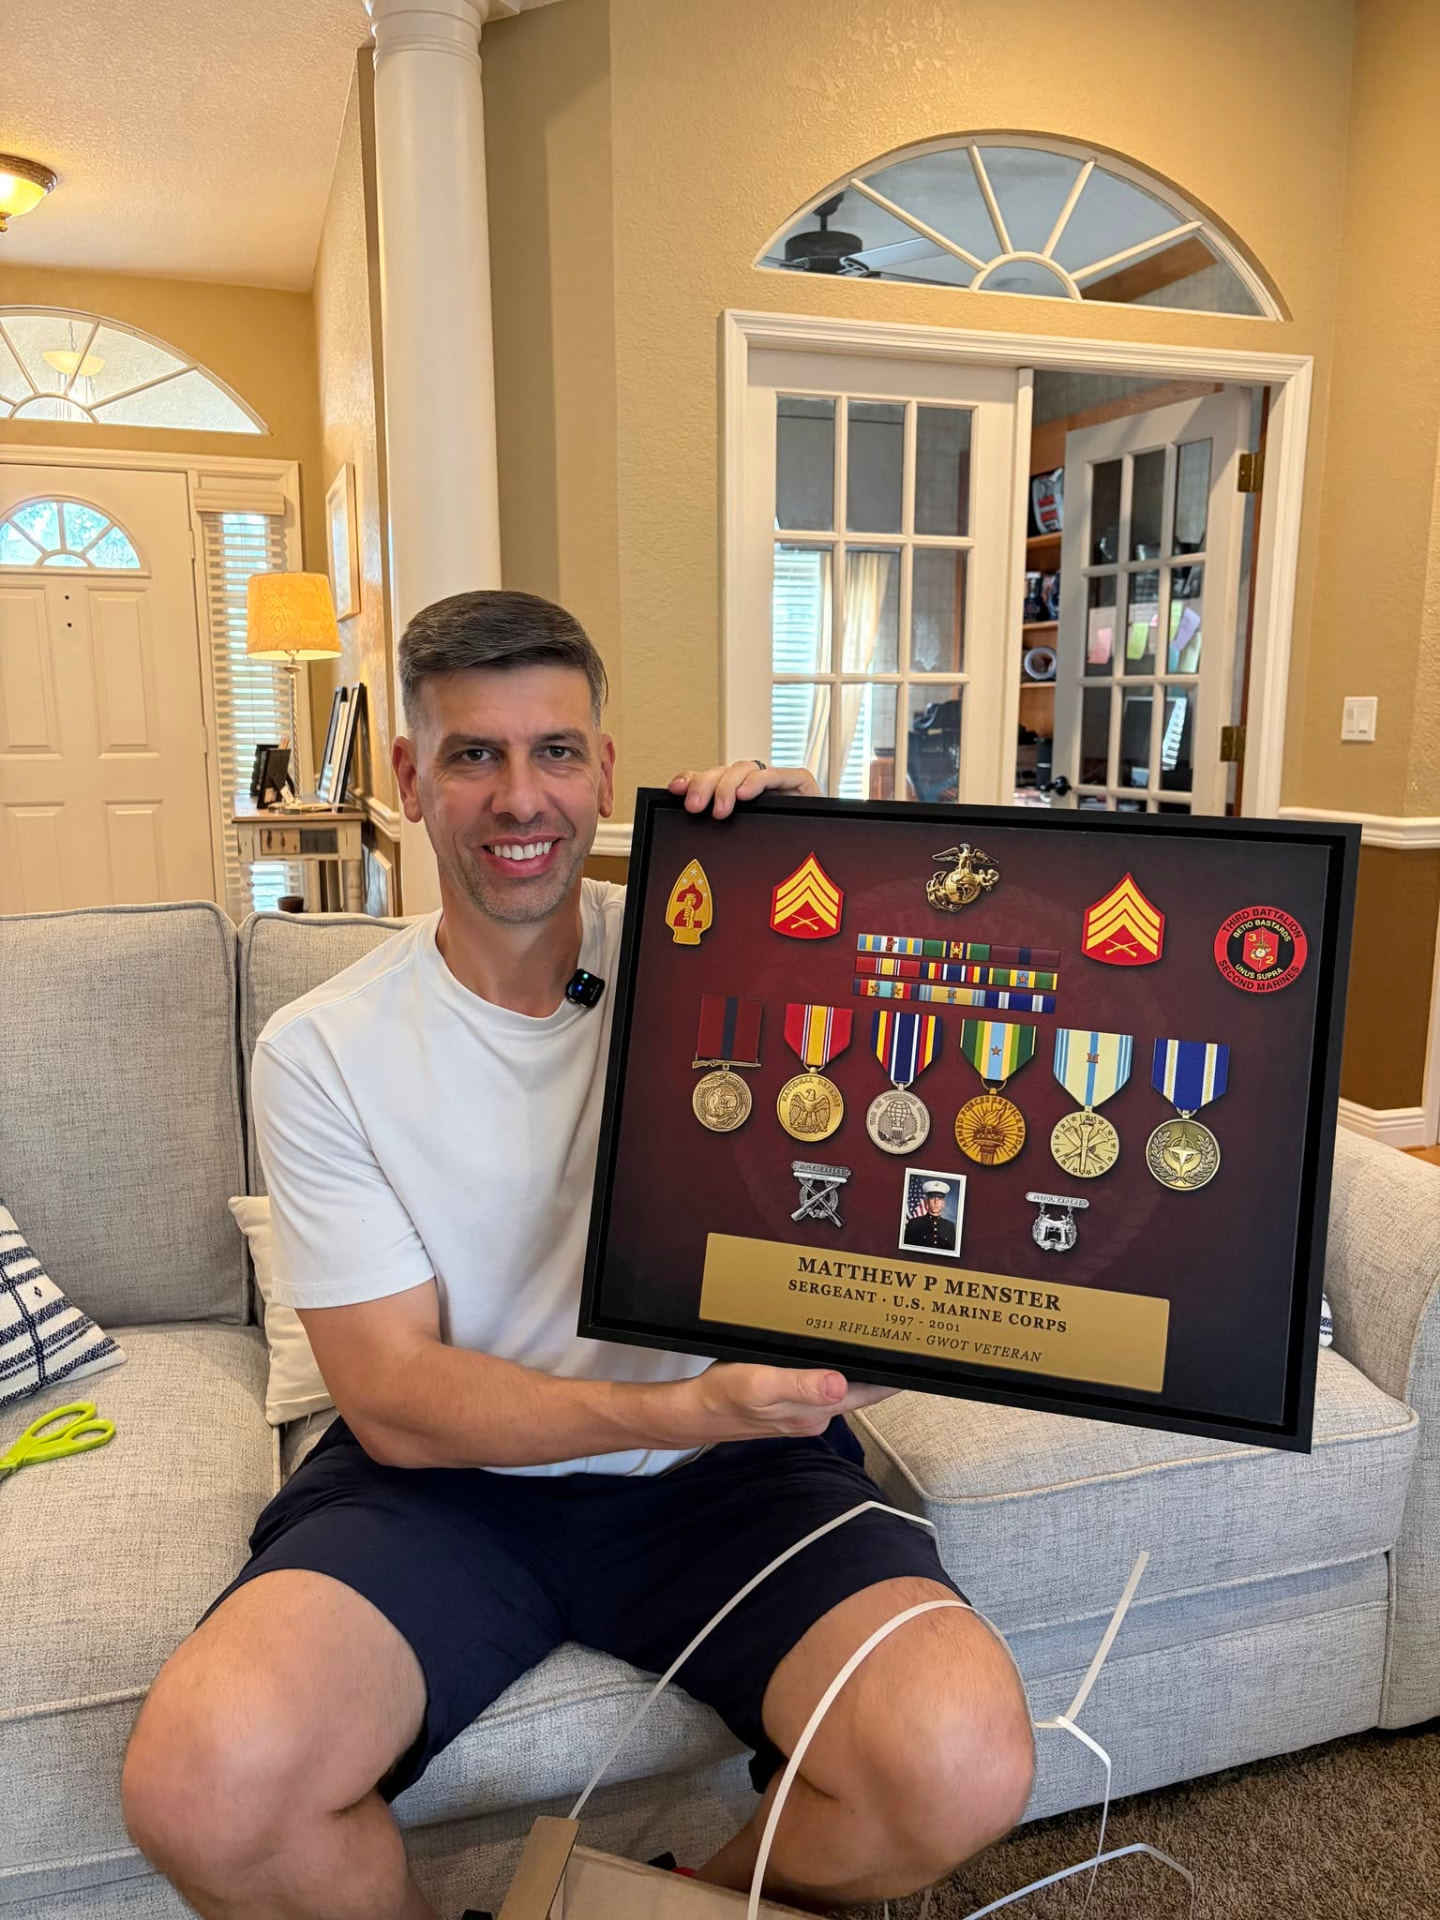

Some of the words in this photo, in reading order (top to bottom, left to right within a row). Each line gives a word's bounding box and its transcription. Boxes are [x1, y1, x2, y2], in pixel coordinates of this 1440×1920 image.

[1223, 911, 1249, 933] THIRD
[1252, 908, 1302, 938] BATTALION
[1233, 921, 1254, 938] BETIO
[1255, 919, 1291, 942] BASTARDS
[1249, 934, 1257, 942] 3
[1235, 963, 1255, 979] UNUS
[1256, 967, 1284, 980] SUPRA
[1265, 955, 1274, 964] 2
[1219, 959, 1254, 989] SECOND
[1256, 965, 1300, 991] MARINES
[797, 1256, 918, 1289] MATTHEW
[923, 1275, 938, 1292] P
[944, 1278, 1062, 1312] MENSTER
[788, 1279, 877, 1304] SERGEANT
[893, 1295, 926, 1312] U.S.
[931, 1301, 1003, 1323] MARINE
[1008, 1313, 1067, 1333] CORPS
[884, 1312, 914, 1327] 1997
[929, 1319, 961, 1333] 2001
[805, 1317, 834, 1330] 0311
[838, 1320, 913, 1342] RIFLEMAN
[926, 1334, 970, 1351] GWOT
[974, 1342, 1043, 1363] VETERAN
